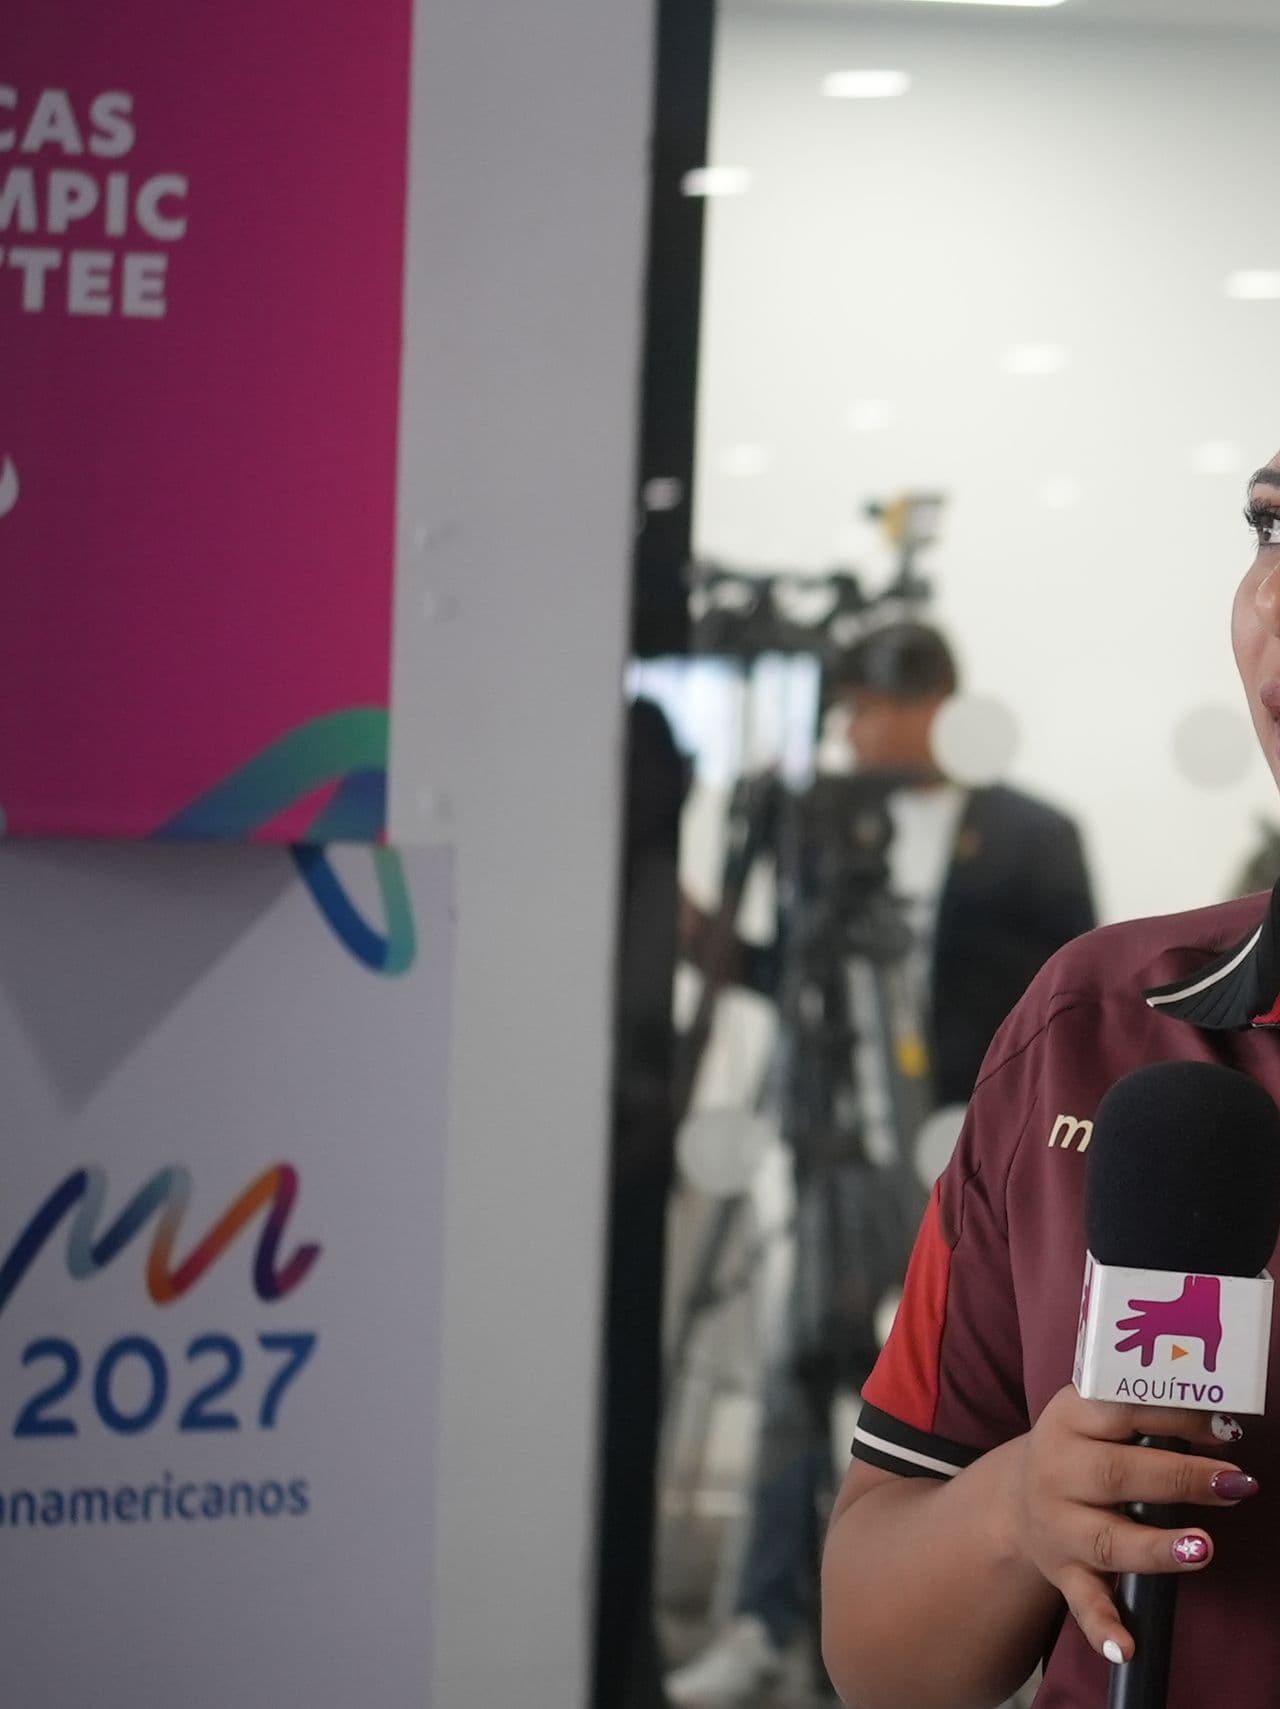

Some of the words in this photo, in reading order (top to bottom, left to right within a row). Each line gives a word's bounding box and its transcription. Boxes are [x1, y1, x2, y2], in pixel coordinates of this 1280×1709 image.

[0, 248, 168, 318] TEE
[13, 1332, 318, 1438] 2027
[0, 1471, 309, 1527] namericanos
